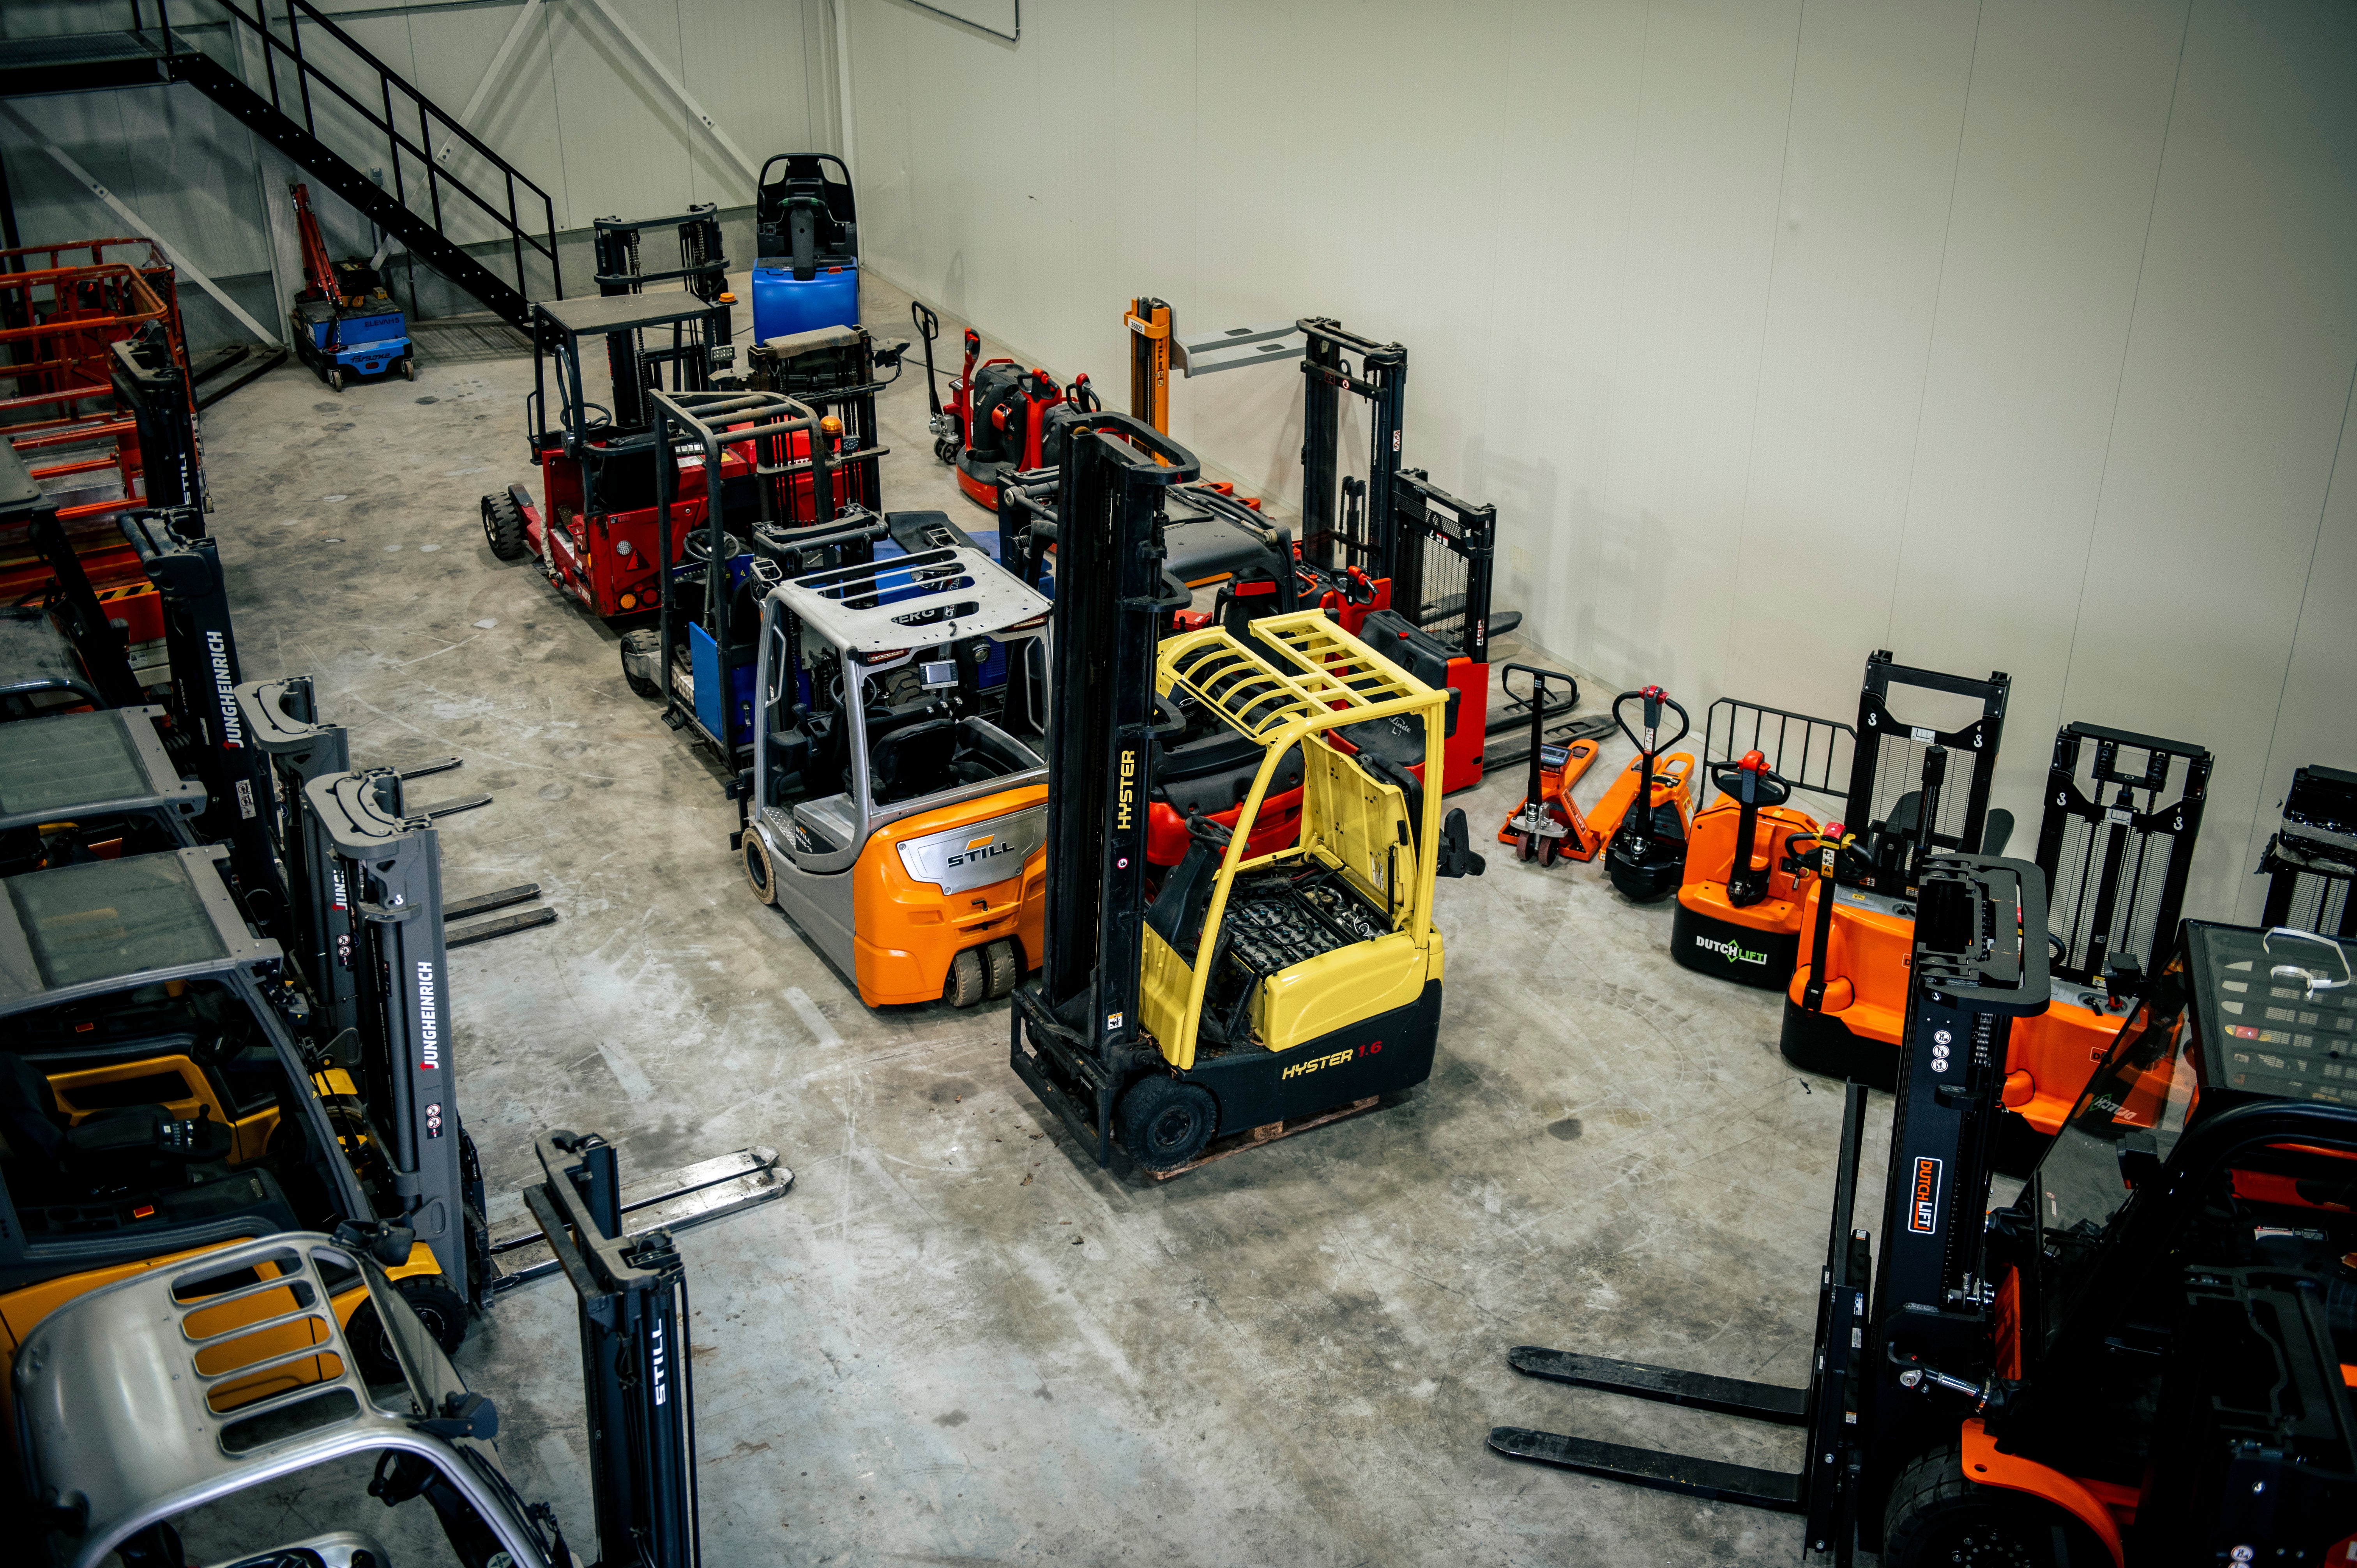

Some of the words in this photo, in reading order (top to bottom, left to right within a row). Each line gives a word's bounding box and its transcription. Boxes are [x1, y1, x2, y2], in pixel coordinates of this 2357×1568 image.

[1131, 321, 1143, 332] 36022
[207, 631, 244, 748] JUNGHEINRICH
[1389, 717, 1411, 733] Linde
[1118, 750, 1135, 829] HYSTER
[795, 826, 812, 845] STILL
[947, 841, 1015, 868] STILL
[417, 962, 439, 1069] JUNGHEINRICH
[1282, 1049, 1353, 1080] HYSTER
[1358, 1041, 1382, 1057] 1.6
[652, 1318, 666, 1406] STILL
